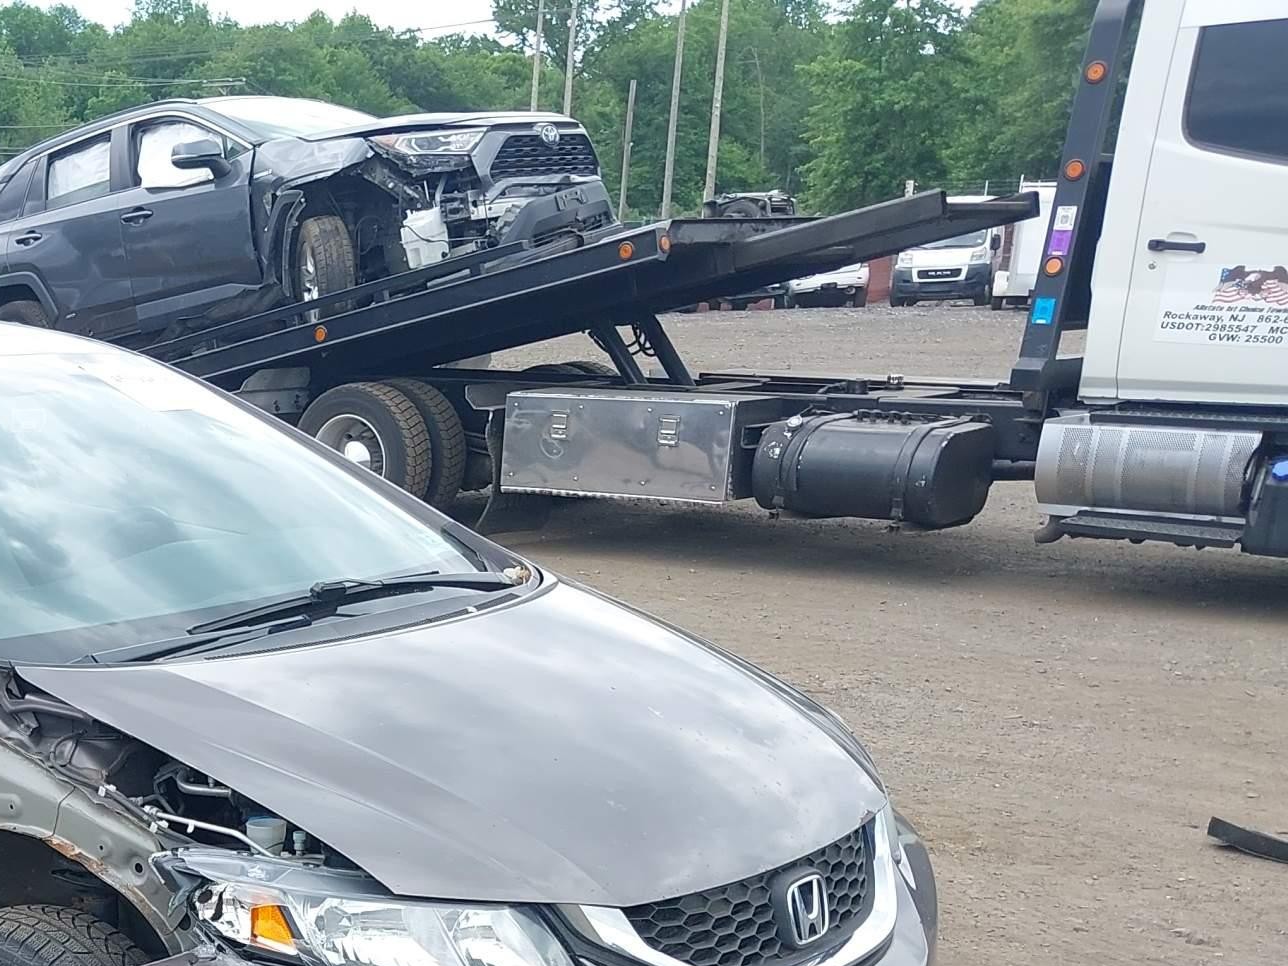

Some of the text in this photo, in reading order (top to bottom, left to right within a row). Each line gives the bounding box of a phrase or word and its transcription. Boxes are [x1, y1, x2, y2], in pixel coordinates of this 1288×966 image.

[1163, 310, 1224, 324] Rockaway,
[1229, 314, 1246, 322] NJ
[1161, 321, 1257, 333] USDOT:2985547
[1208, 332, 1284, 344] GVW: 25500
